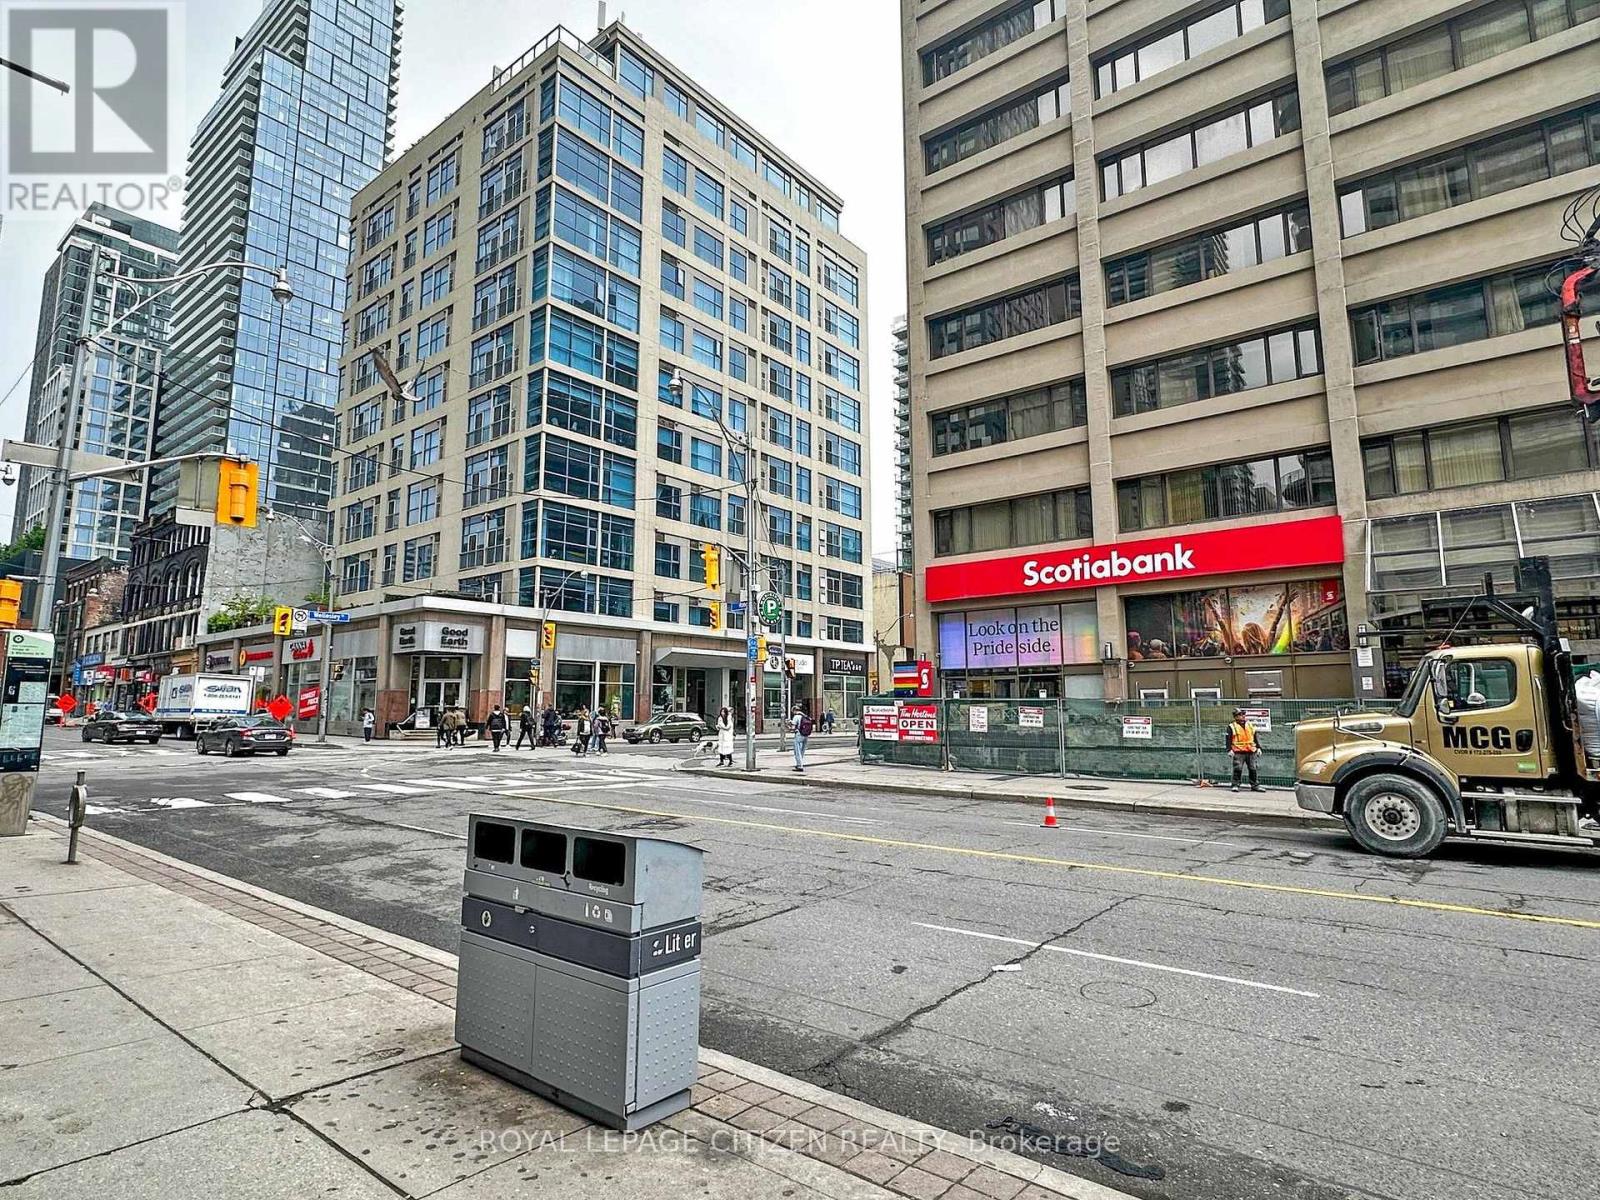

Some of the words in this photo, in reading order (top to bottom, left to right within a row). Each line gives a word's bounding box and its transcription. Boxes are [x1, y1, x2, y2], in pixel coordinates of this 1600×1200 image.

[1023, 543, 1196, 586] Scotiabank
[766, 600, 777, 614] P
[441, 626, 469, 637] Good
[968, 621, 1005, 637] Look
[1007, 622, 1030, 635] on
[1032, 617, 1059, 633] the
[440, 635, 469, 646] Earth
[973, 639, 1014, 656] Pride
[1018, 637, 1056, 654] side.
[831, 659, 840, 670] TP
[841, 660, 851, 671] TEA
[901, 720, 935, 729] OPEN
[1442, 725, 1512, 750] MCG
